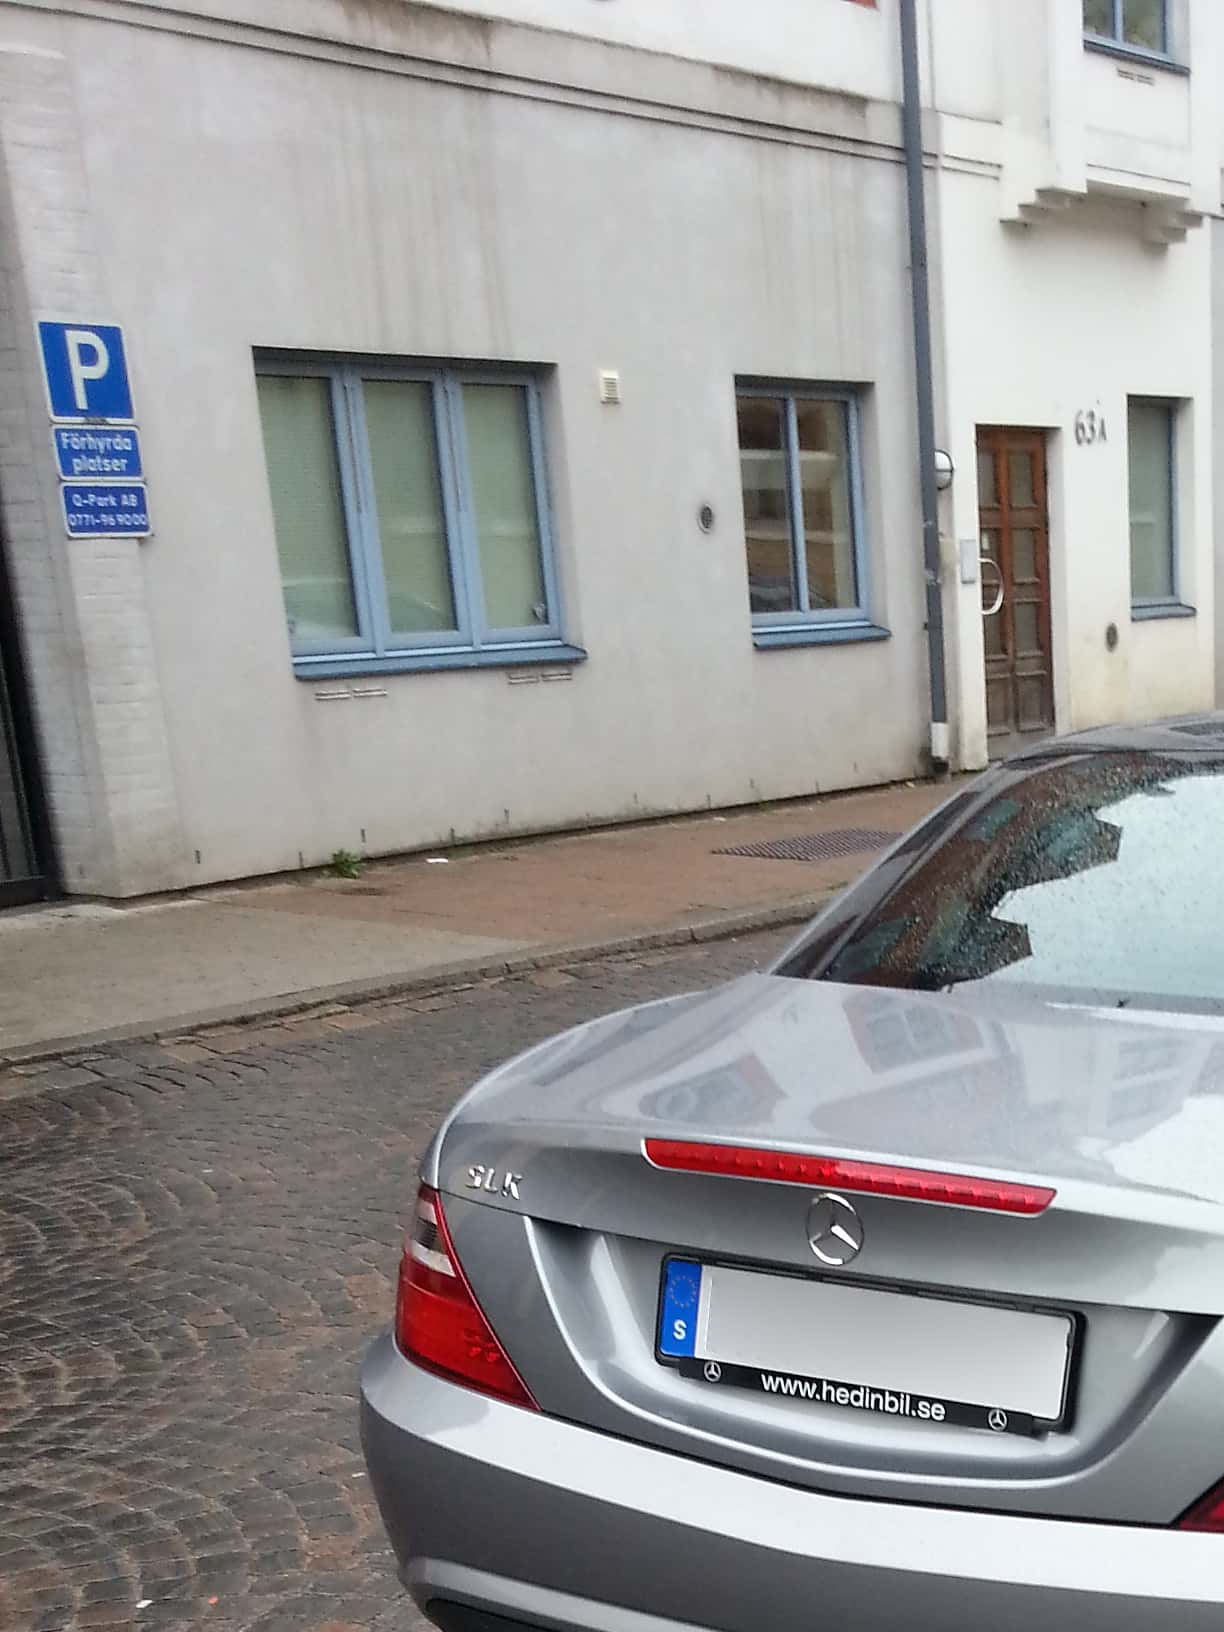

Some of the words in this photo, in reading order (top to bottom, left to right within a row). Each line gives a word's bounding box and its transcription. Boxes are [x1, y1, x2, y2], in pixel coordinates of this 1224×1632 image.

[64, 329, 110, 411] P
[60, 432, 132, 454] Förhyrda
[72, 455, 128, 475] platser
[72, 494, 117, 507] Q-Park
[465, 1164, 523, 1200] SLK
[672, 1319, 688, 1341] S
[760, 1373, 946, 1422] www.hedinbil.se
